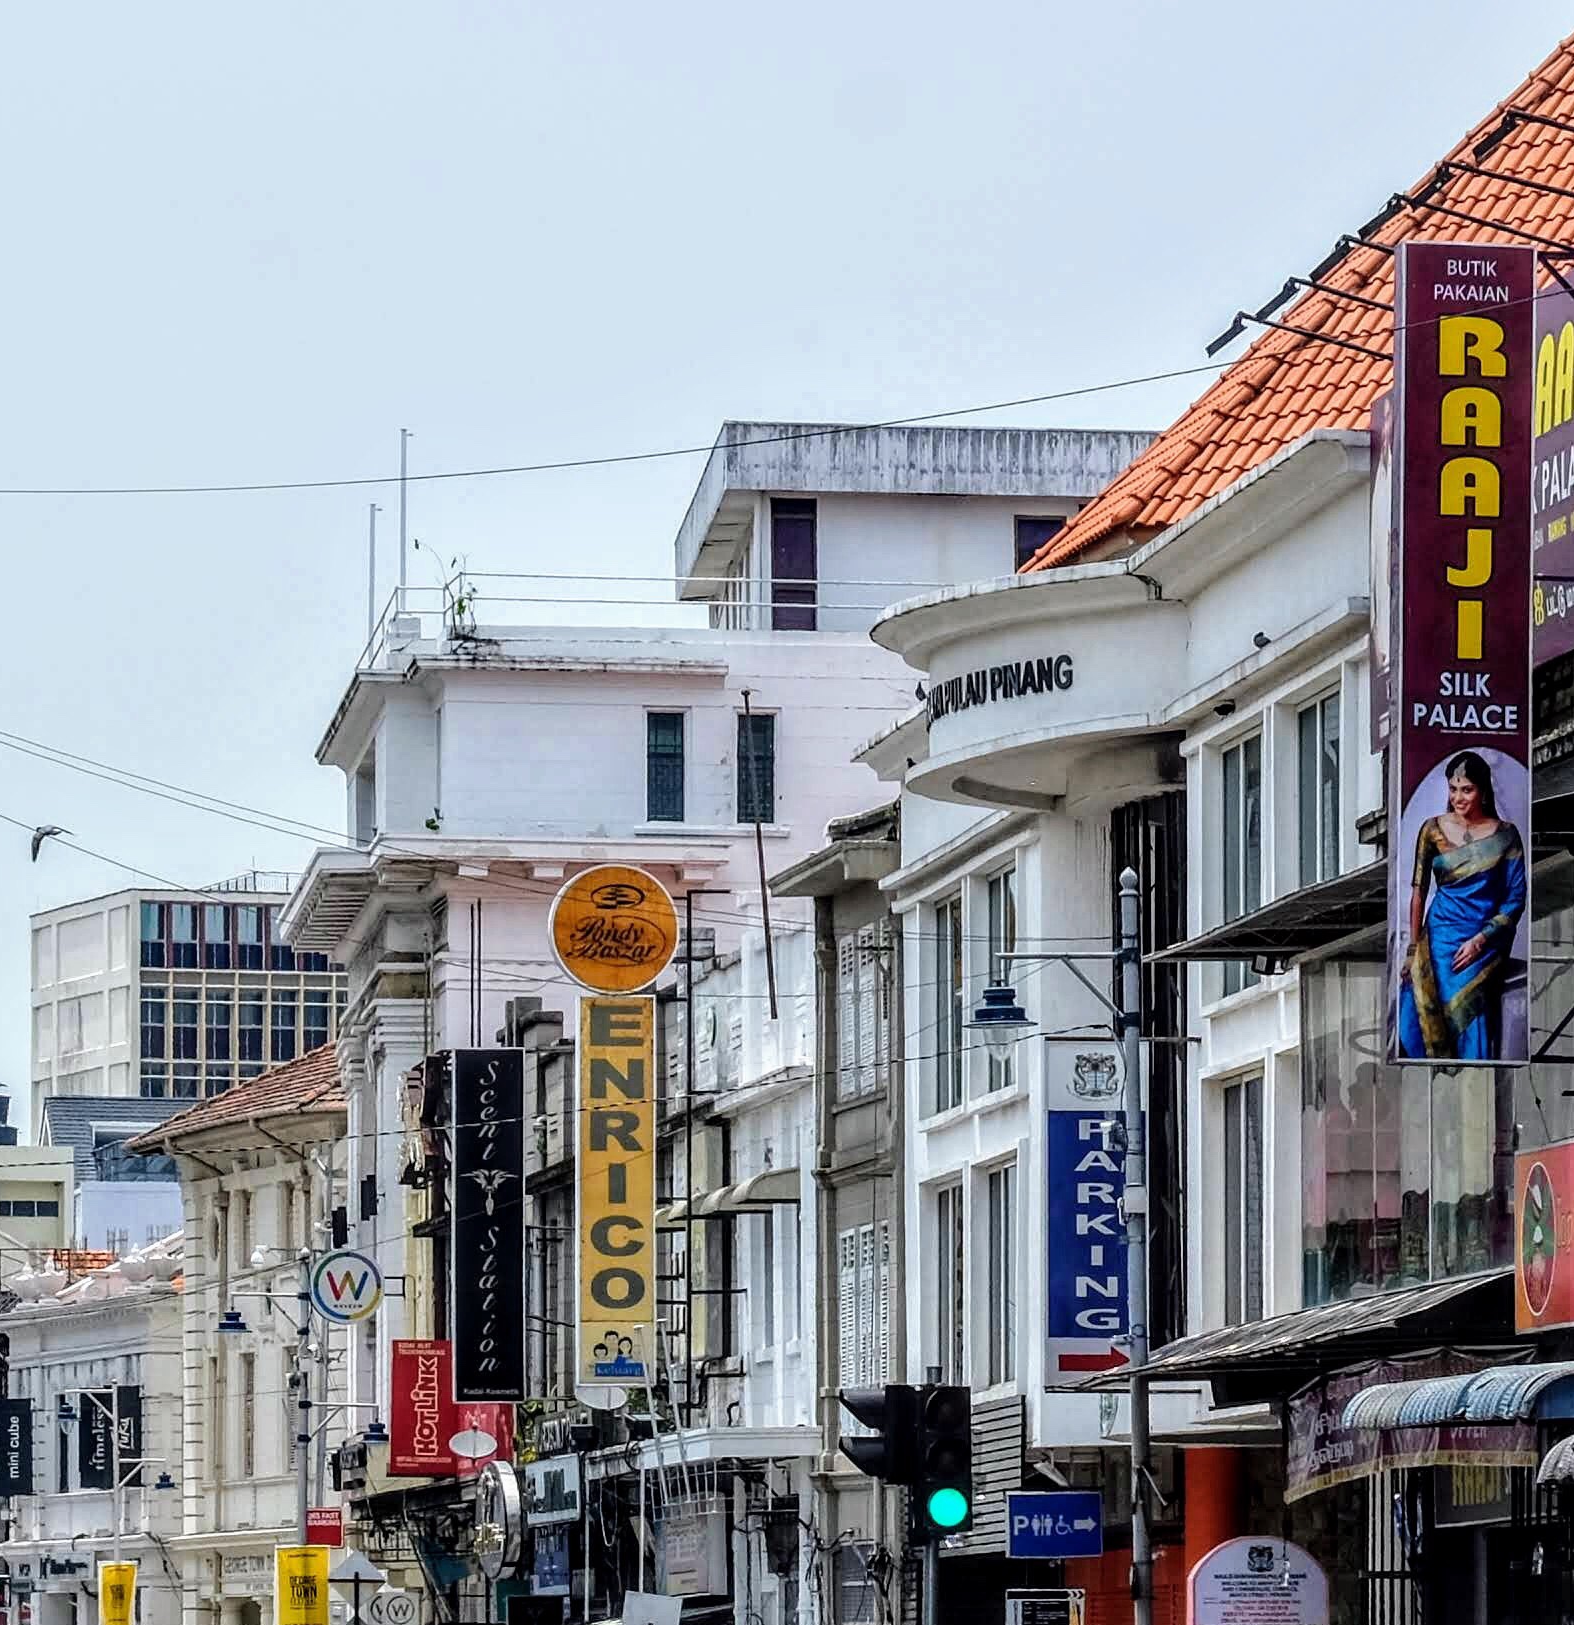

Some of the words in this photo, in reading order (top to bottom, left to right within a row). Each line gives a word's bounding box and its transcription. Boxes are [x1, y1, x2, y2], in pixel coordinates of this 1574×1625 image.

[1446, 259, 1497, 278] BUTIK
[1433, 282, 1509, 304] PAKAIAN
[1438, 314, 1507, 661] RAAJI
[989, 654, 1074, 702] PINANG
[1439, 671, 1491, 698] SILK
[1412, 703, 1519, 732] PALACE
[588, 1004, 646, 1310] ENRICO
[1073, 1118, 1121, 1331] PARKING
[7, 1415, 20, 1449] cube
[8, 1449, 20, 1479] mini
[1013, 1515, 1030, 1537] P
[289, 1584, 318, 1599] TOWN
